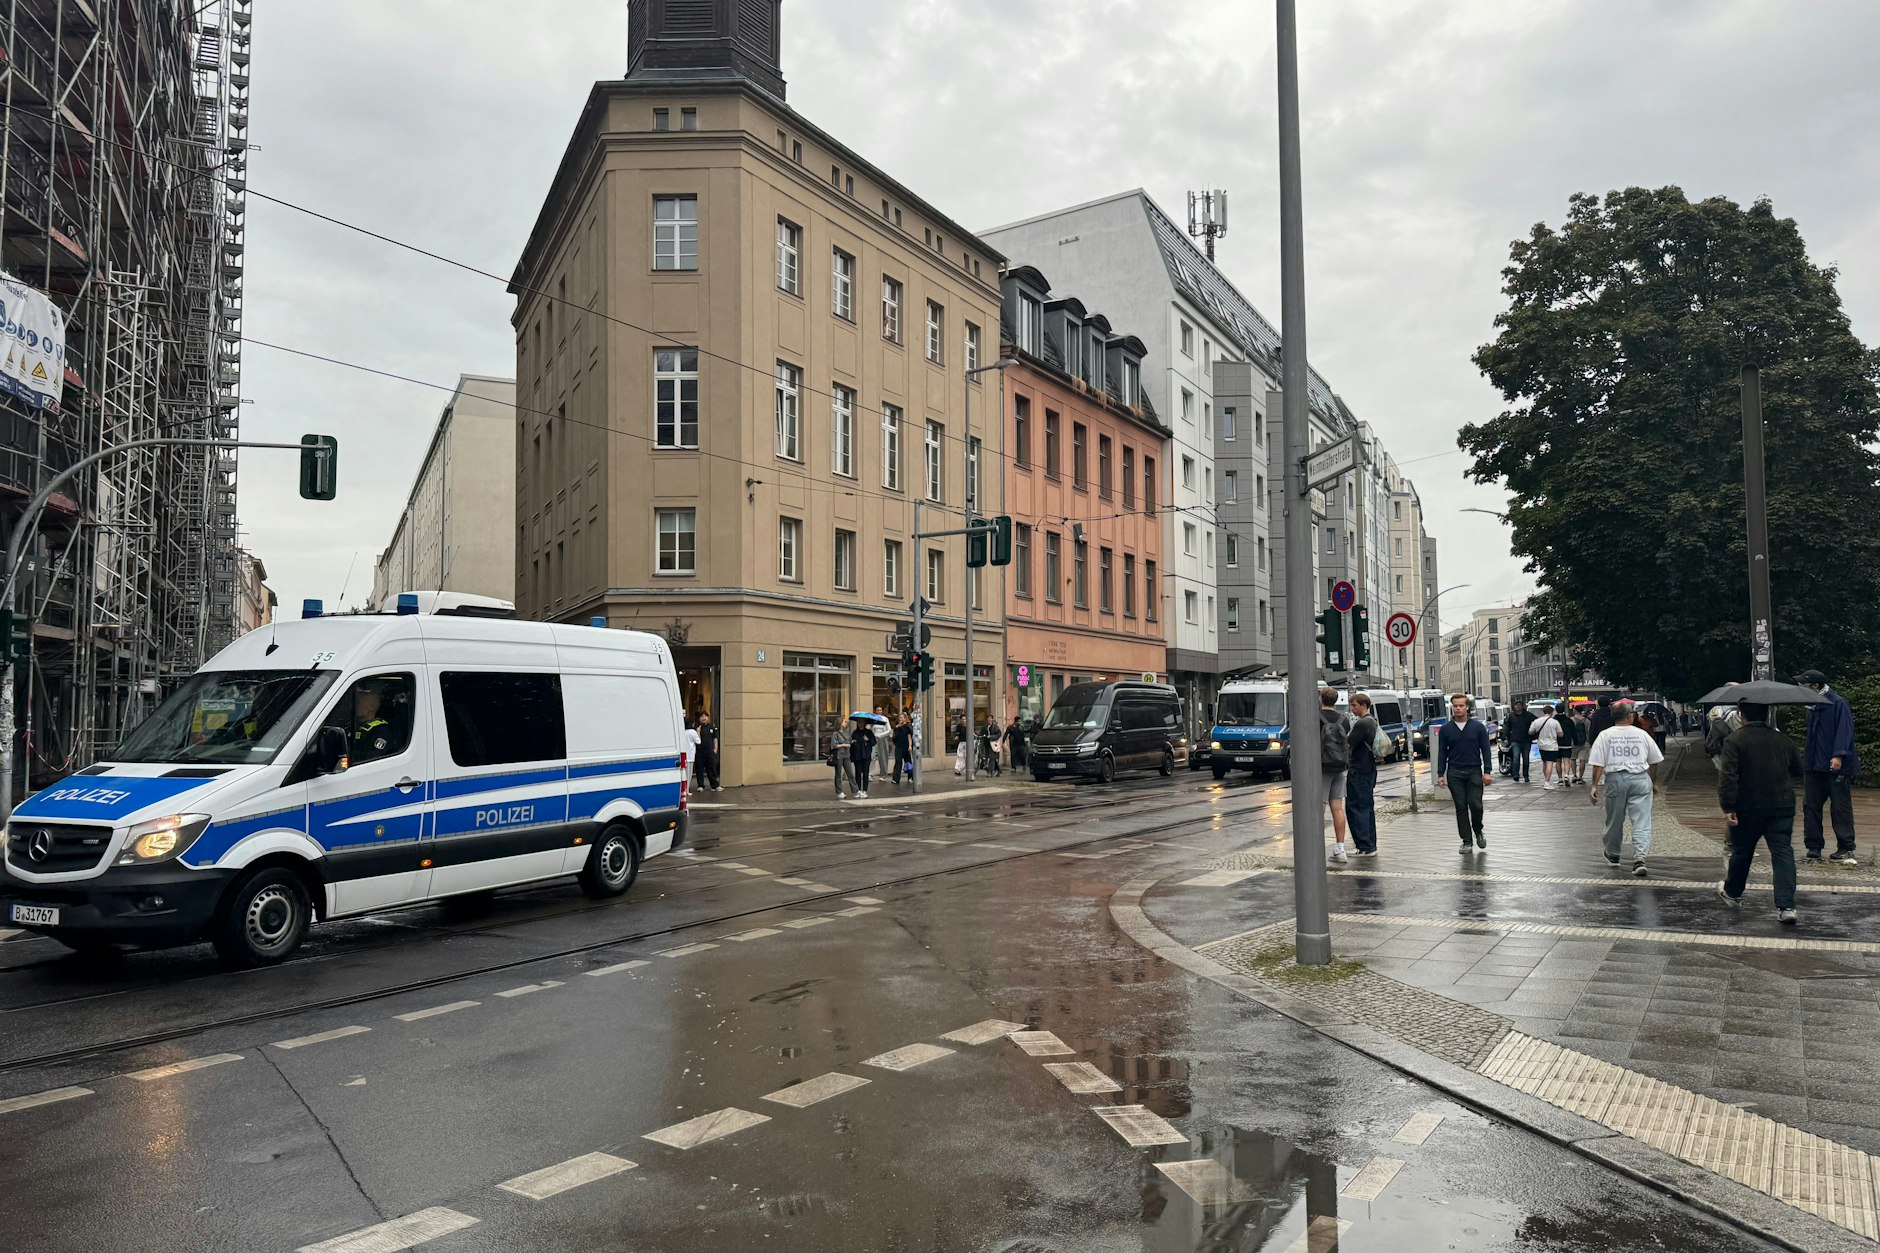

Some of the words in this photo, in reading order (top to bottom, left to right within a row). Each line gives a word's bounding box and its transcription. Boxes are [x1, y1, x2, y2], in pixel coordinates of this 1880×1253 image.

[1391, 621, 1410, 638] 30
[312, 652, 336, 662] 35
[1610, 745, 1640, 757] 1980
[40, 788, 132, 805] POLIZEI
[475, 805, 535, 827] POLIZEI
[15, 906, 21, 920] B
[25, 908, 54, 922] 31767
